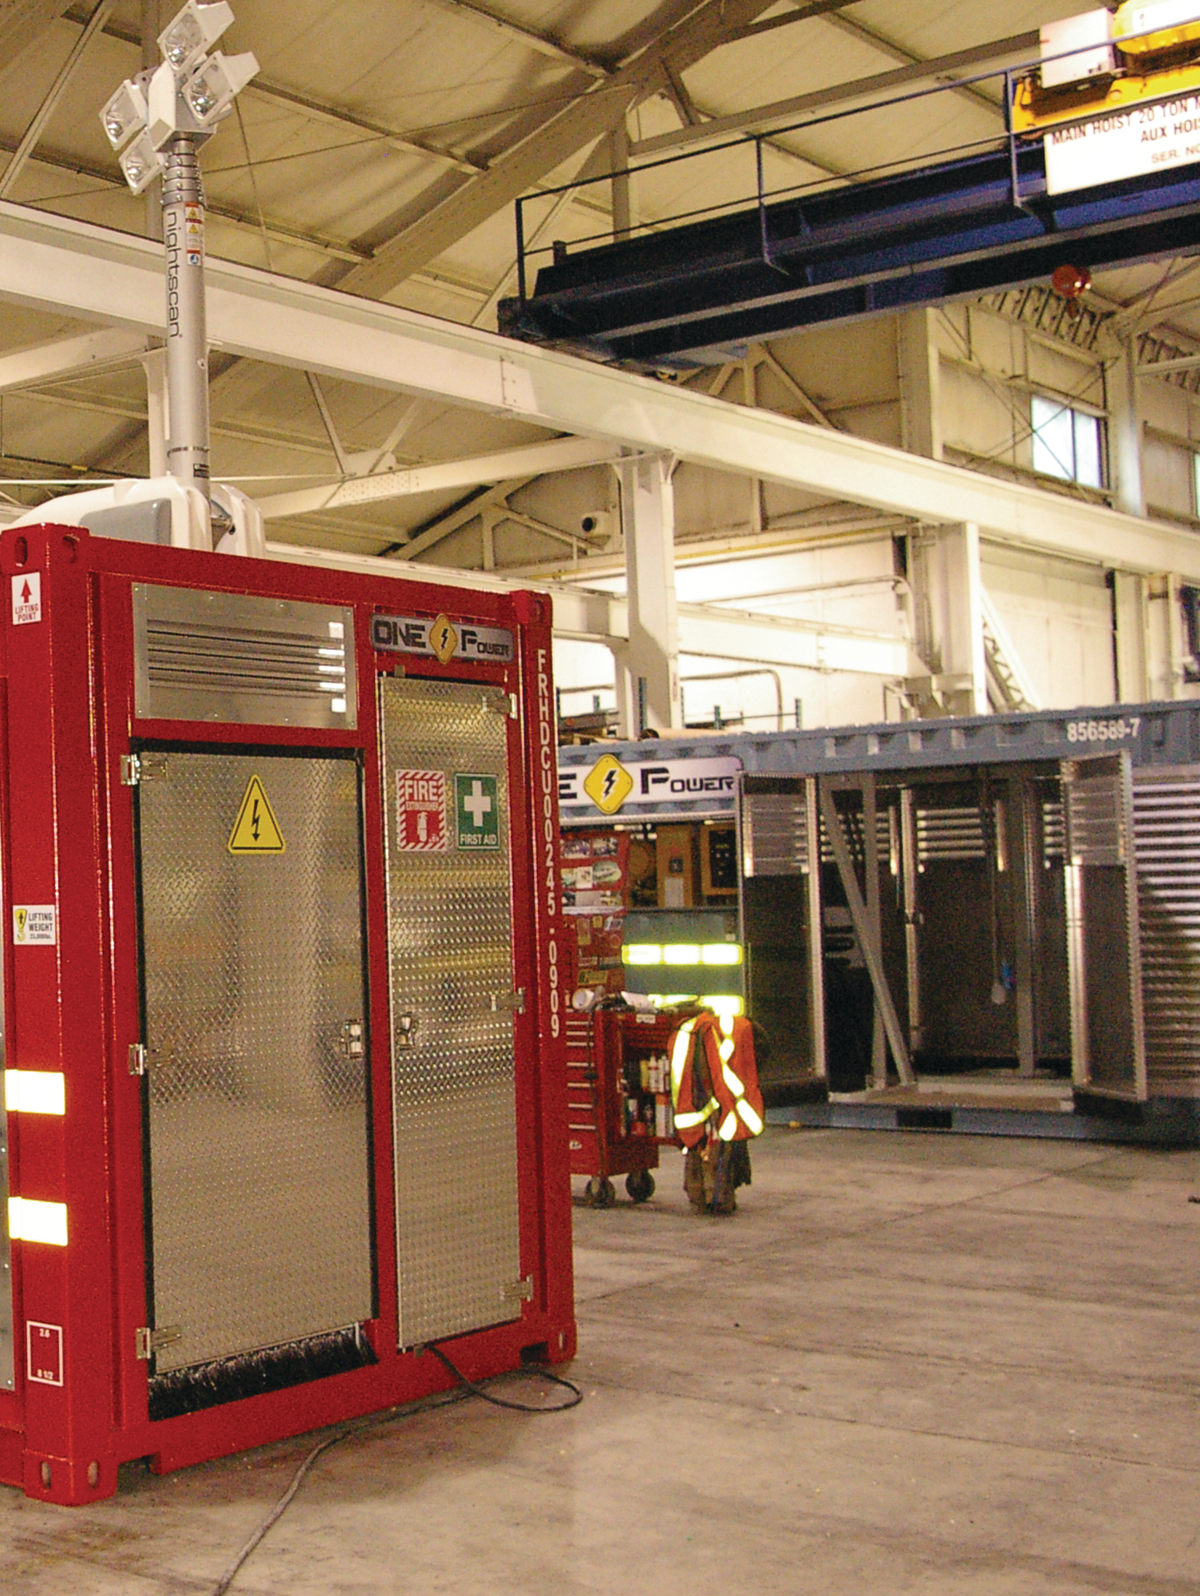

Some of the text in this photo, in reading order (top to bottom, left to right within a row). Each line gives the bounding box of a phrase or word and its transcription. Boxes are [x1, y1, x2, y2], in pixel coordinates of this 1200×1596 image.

[1051, 123, 1087, 145] MAIN
[1092, 111, 1131, 134] HOIST
[1138, 109, 1155, 124] 20
[1160, 98, 1188, 117] TON
[1140, 126, 1168, 143] AUX
[166, 209, 183, 339] nightscan
[15, 603, 39, 615] LIFTING
[17, 611, 37, 622] POINT
[373, 620, 510, 656] ONE POWER
[1067, 717, 1141, 742] 856589-7
[405, 780, 438, 801] FIRE
[640, 767, 735, 795] POWER
[460, 834, 497, 845] FIRST AID
[28, 912, 52, 921] LIFTING
[28, 923, 53, 932] WEIGHT
